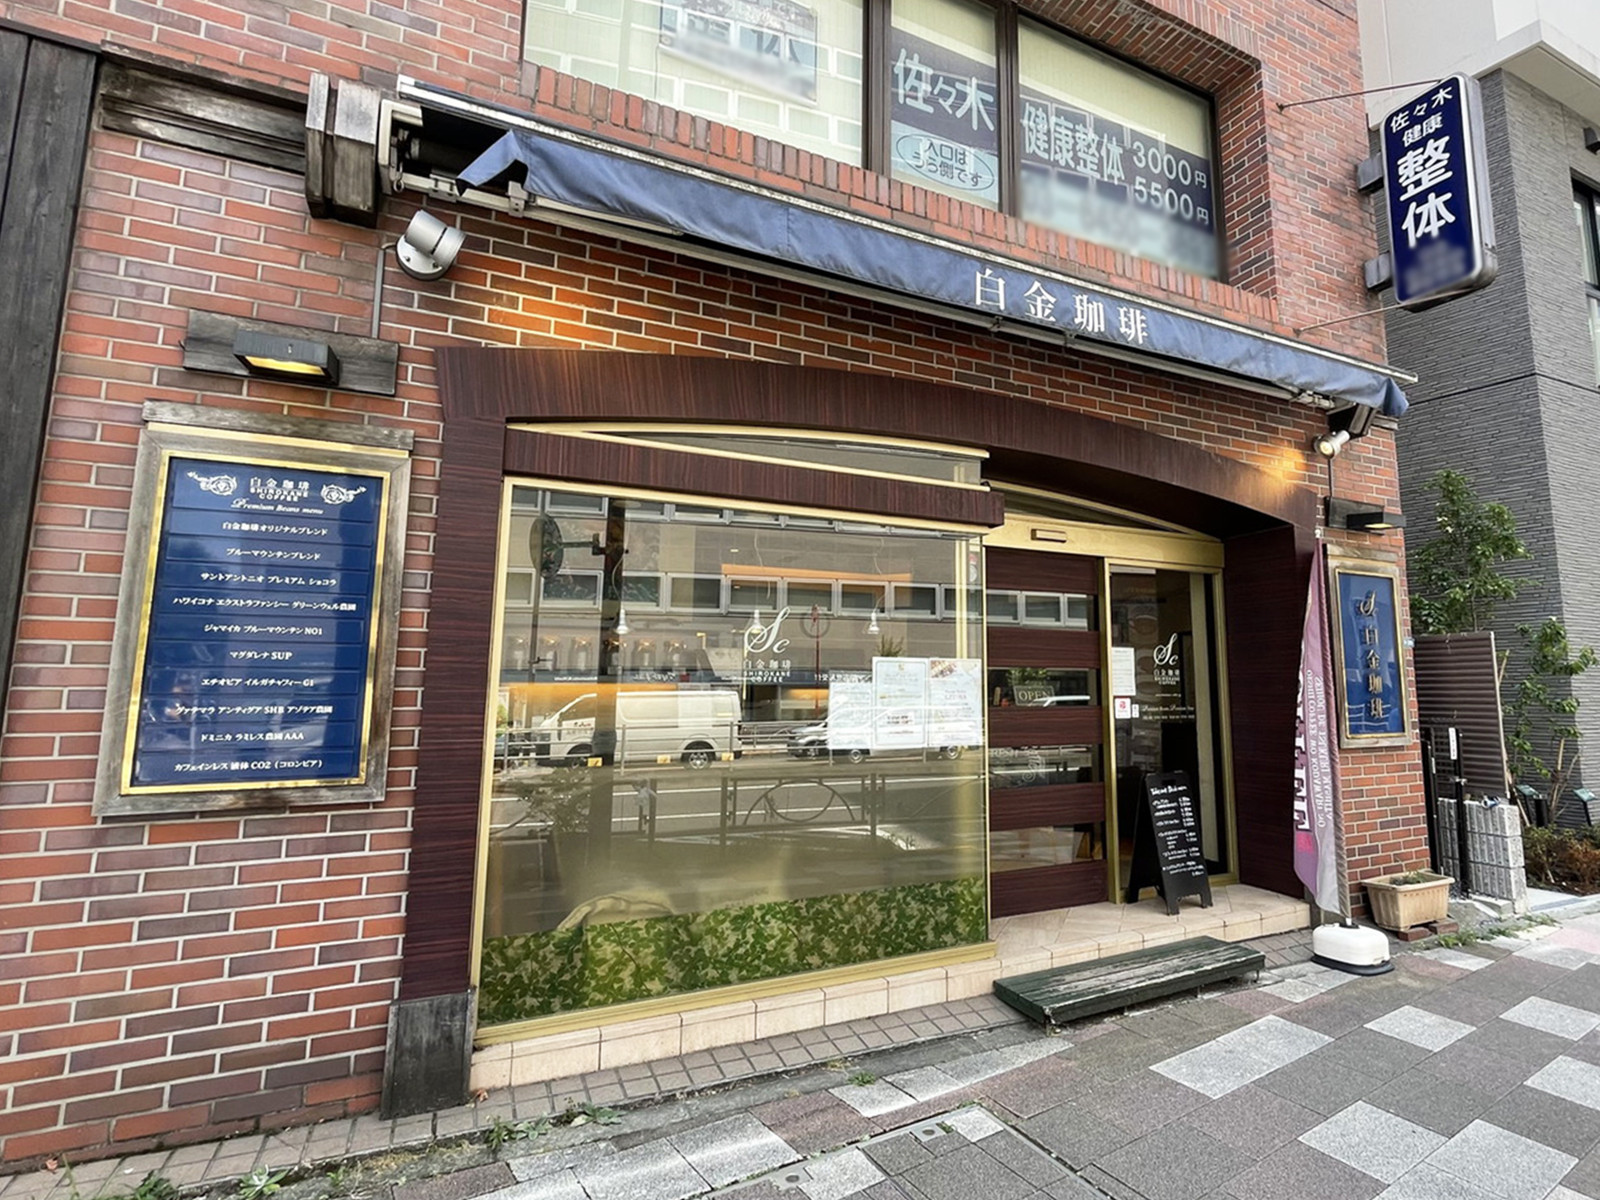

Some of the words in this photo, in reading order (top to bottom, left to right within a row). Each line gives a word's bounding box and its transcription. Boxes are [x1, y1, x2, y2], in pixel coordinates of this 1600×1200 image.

[893, 47, 995, 131] 佐々木
[1390, 86, 1453, 133] 佐々木
[1402, 112, 1443, 147] 健康
[1020, 101, 1125, 185] 健康整体
[925, 139, 968, 165] 入口は
[912, 152, 982, 187] うら側です
[1397, 135, 1456, 249] 整体
[975, 268, 1149, 345] 白金珈琲
[230, 497, 274, 511] Premium
[259, 493, 299, 502] COFFEE
[226, 548, 321, 561] ブルーマウンテンブレンド
[200, 572, 265, 584] サントアントニオ
[267, 575, 305, 585] プレミアム
[308, 577, 337, 587] ショコラ
[172, 597, 215, 606] ハワイコナ
[216, 598, 290, 608] エクストラファンシー
[203, 623, 241, 633] ジャマイカ
[243, 624, 304, 635] ブルーマウンテン
[304, 628, 323, 636] NO1
[229, 650, 270, 659] マグダレナ
[271, 651, 293, 661] SUP
[200, 677, 242, 686] エチオピア
[263, 705, 285, 714] SHB
[200, 733, 233, 742] ドミニカ
[284, 732, 304, 741] AAA
[174, 762, 229, 772] カフェインレス
[250, 761, 271, 770] CO2
